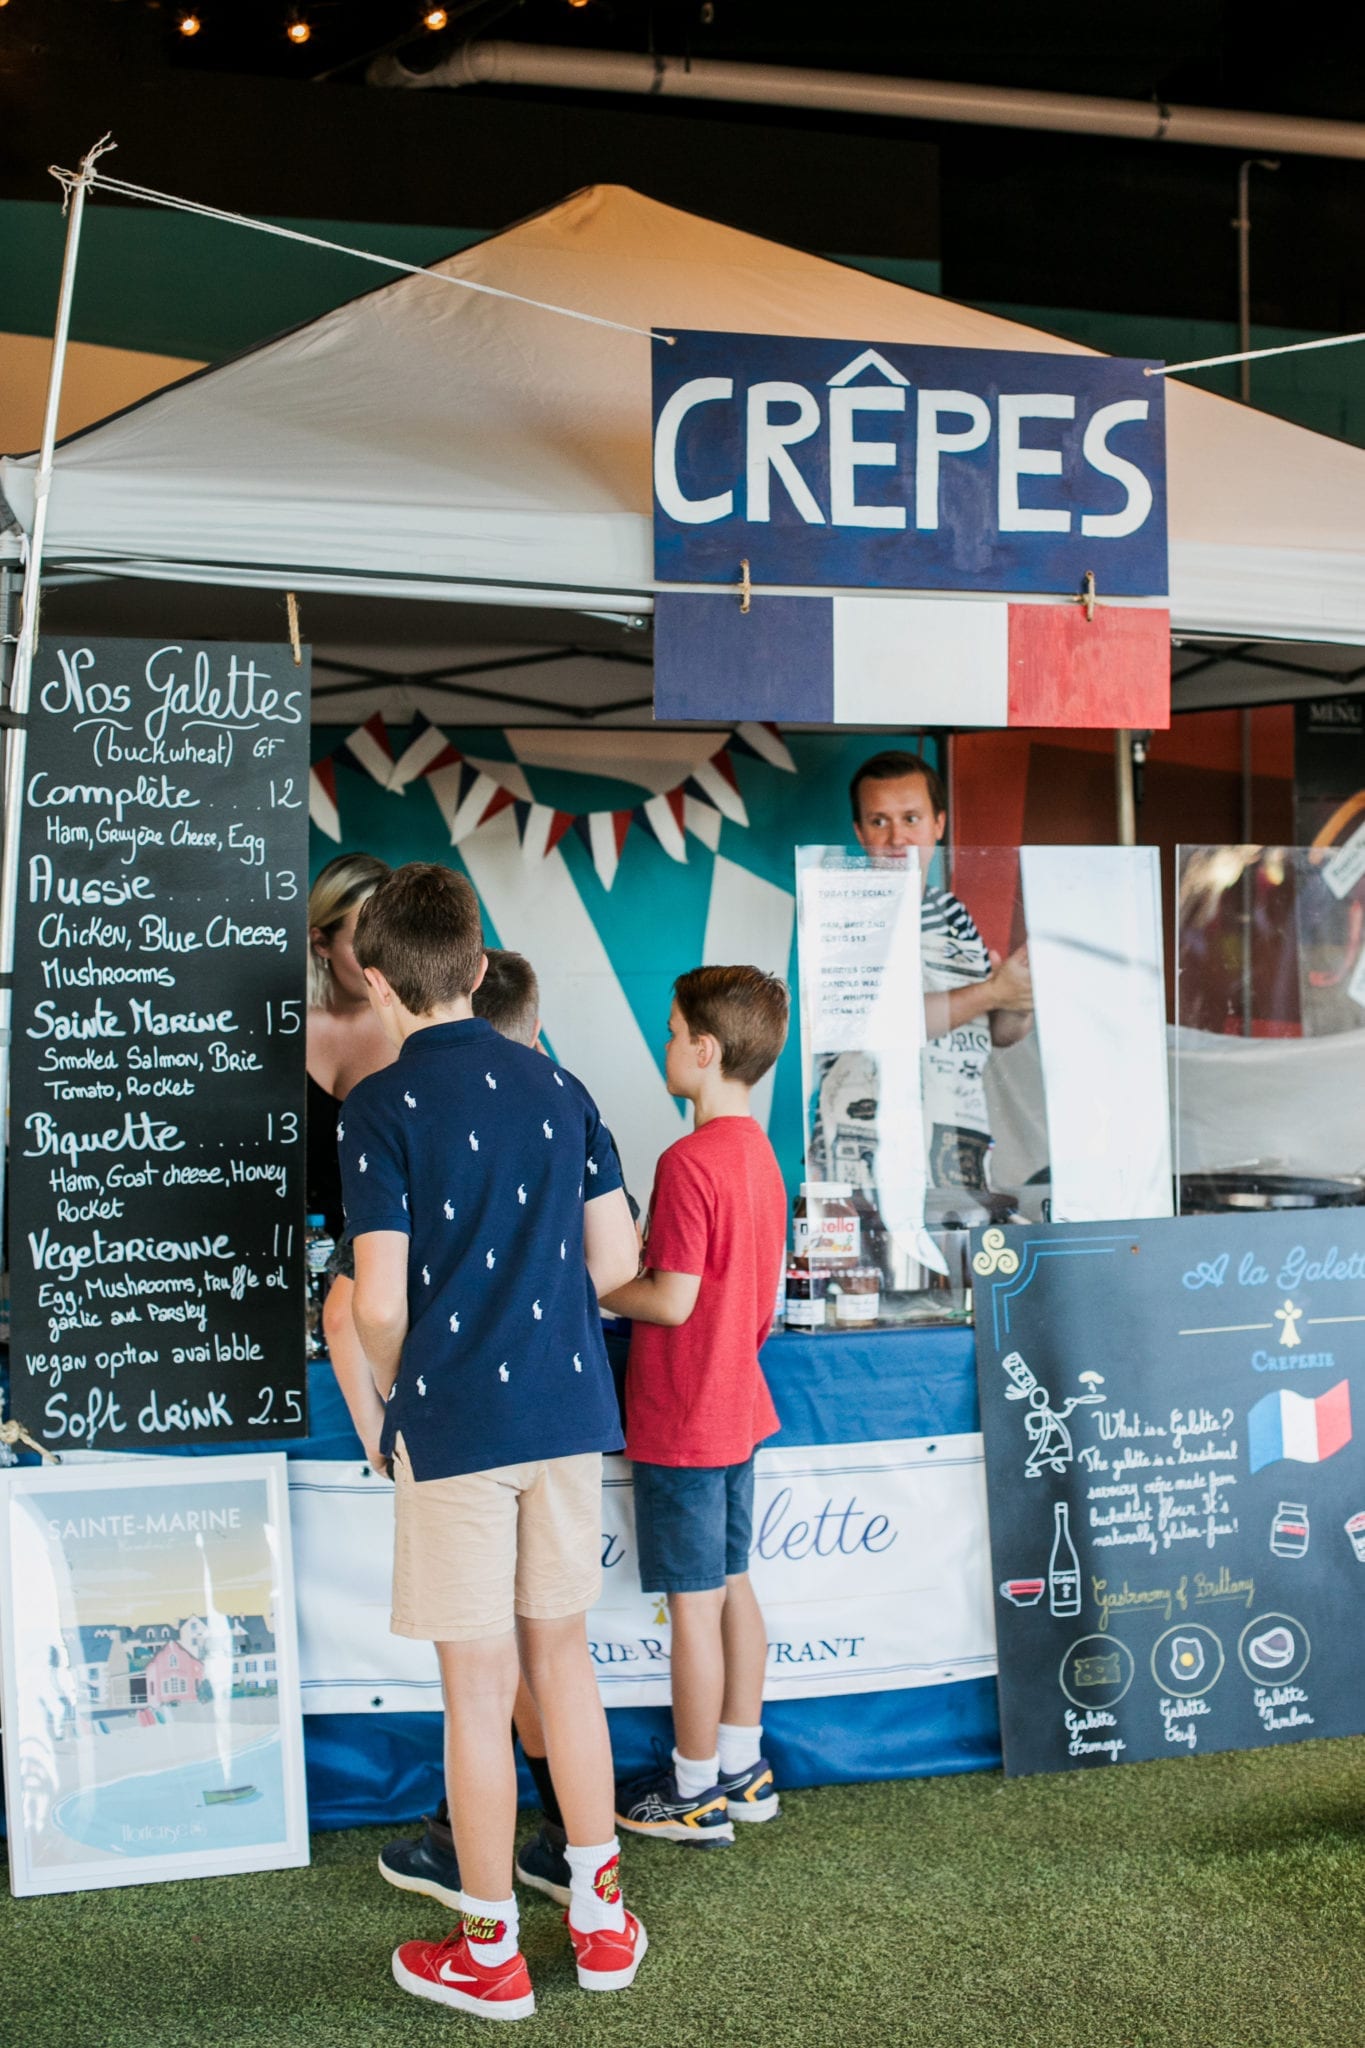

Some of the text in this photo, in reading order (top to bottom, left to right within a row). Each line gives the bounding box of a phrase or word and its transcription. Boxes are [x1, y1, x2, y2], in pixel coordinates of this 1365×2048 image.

[654, 348, 1153, 539] CRÊPES
[40, 646, 302, 741] Nos Galettes
[93, 725, 233, 767] (buckwheat)
[27, 772, 302, 822] Complète 12
[47, 816, 93, 850] Ham,
[170, 820, 222, 851] Cheese,
[229, 823, 265, 865] Egg
[28, 854, 298, 906] Aussie 13
[39, 913, 288, 952] Chicken, Blue Cheese,
[41, 957, 175, 988] Mushrooms
[26, 997, 302, 1040] Sainte Marine 15
[38, 1041, 263, 1073] Smoked Salmon, Brie
[44, 1076, 195, 1101] Tomato, Rocket
[23, 1111, 298, 1168] Biquette 13
[49, 1159, 287, 1198] Ham, Goat cheese, Honey
[57, 1197, 125, 1222] Rocket
[800, 1217, 856, 1235] ntella
[27, 1224, 293, 1282] Vegetarienne 11
[1182, 1245, 1365, 1290] A la Galett
[38, 1264, 288, 1315] Egg, Mushrooms, truffle oil
[48, 1310, 102, 1343] garlic
[111, 1306, 142, 1324] and
[26, 1332, 264, 1387] vegan option available
[42, 1386, 302, 1448] Soft drink 2.5
[1091, 1408, 1141, 1440] What
[1078, 1445, 1109, 1473] The
[48, 1508, 241, 1540] SAINTE-MARINE
